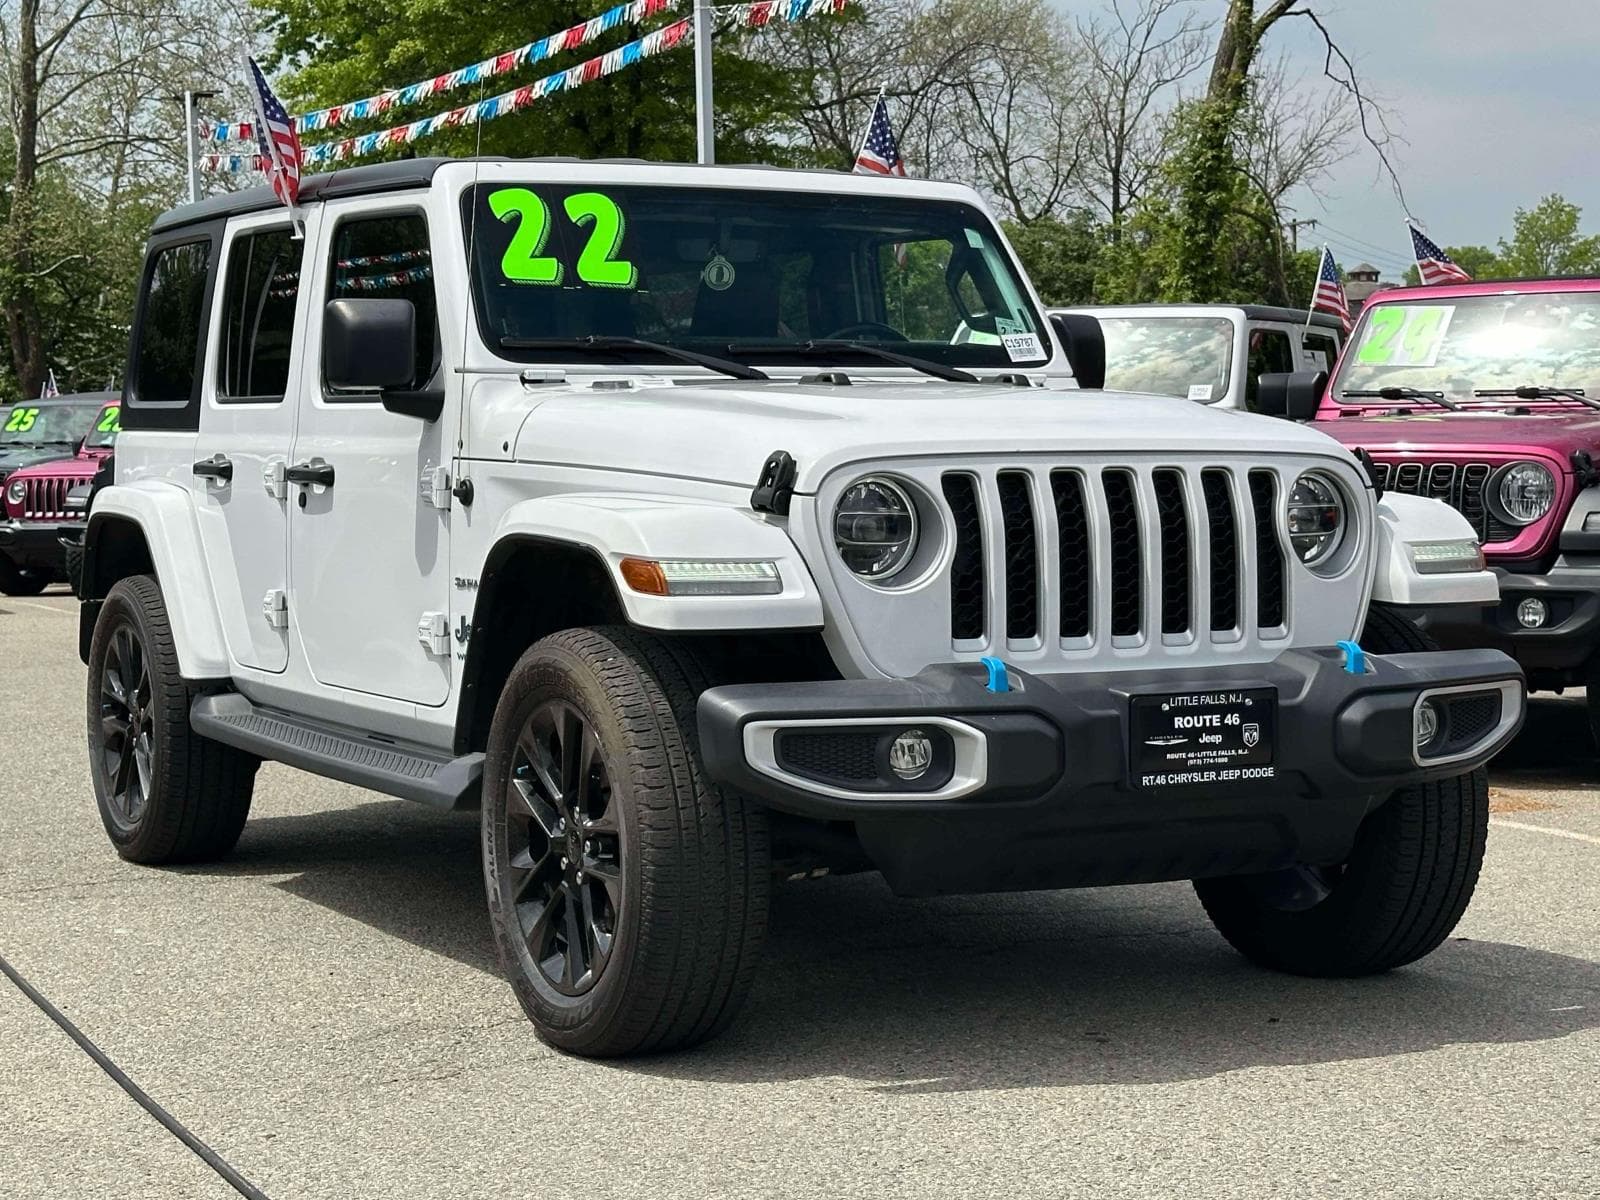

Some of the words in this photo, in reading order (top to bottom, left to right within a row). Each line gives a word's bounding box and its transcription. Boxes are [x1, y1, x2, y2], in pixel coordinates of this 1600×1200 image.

[488, 188, 639, 288] 22
[1359, 307, 1445, 363] 24
[4, 407, 40, 432] 25
[1169, 696, 1199, 707] LITTLE
[1200, 694, 1228, 706] FALLS,
[1174, 714, 1221, 729] ROUTE
[1223, 713, 1241, 726] 46
[1198, 732, 1223, 744] Jeep
[1142, 774, 1167, 786] RT.46
[1167, 771, 1217, 784] CHRYSLER
[1217, 769, 1241, 781] JEEP
[1242, 766, 1275, 779] DODGE
